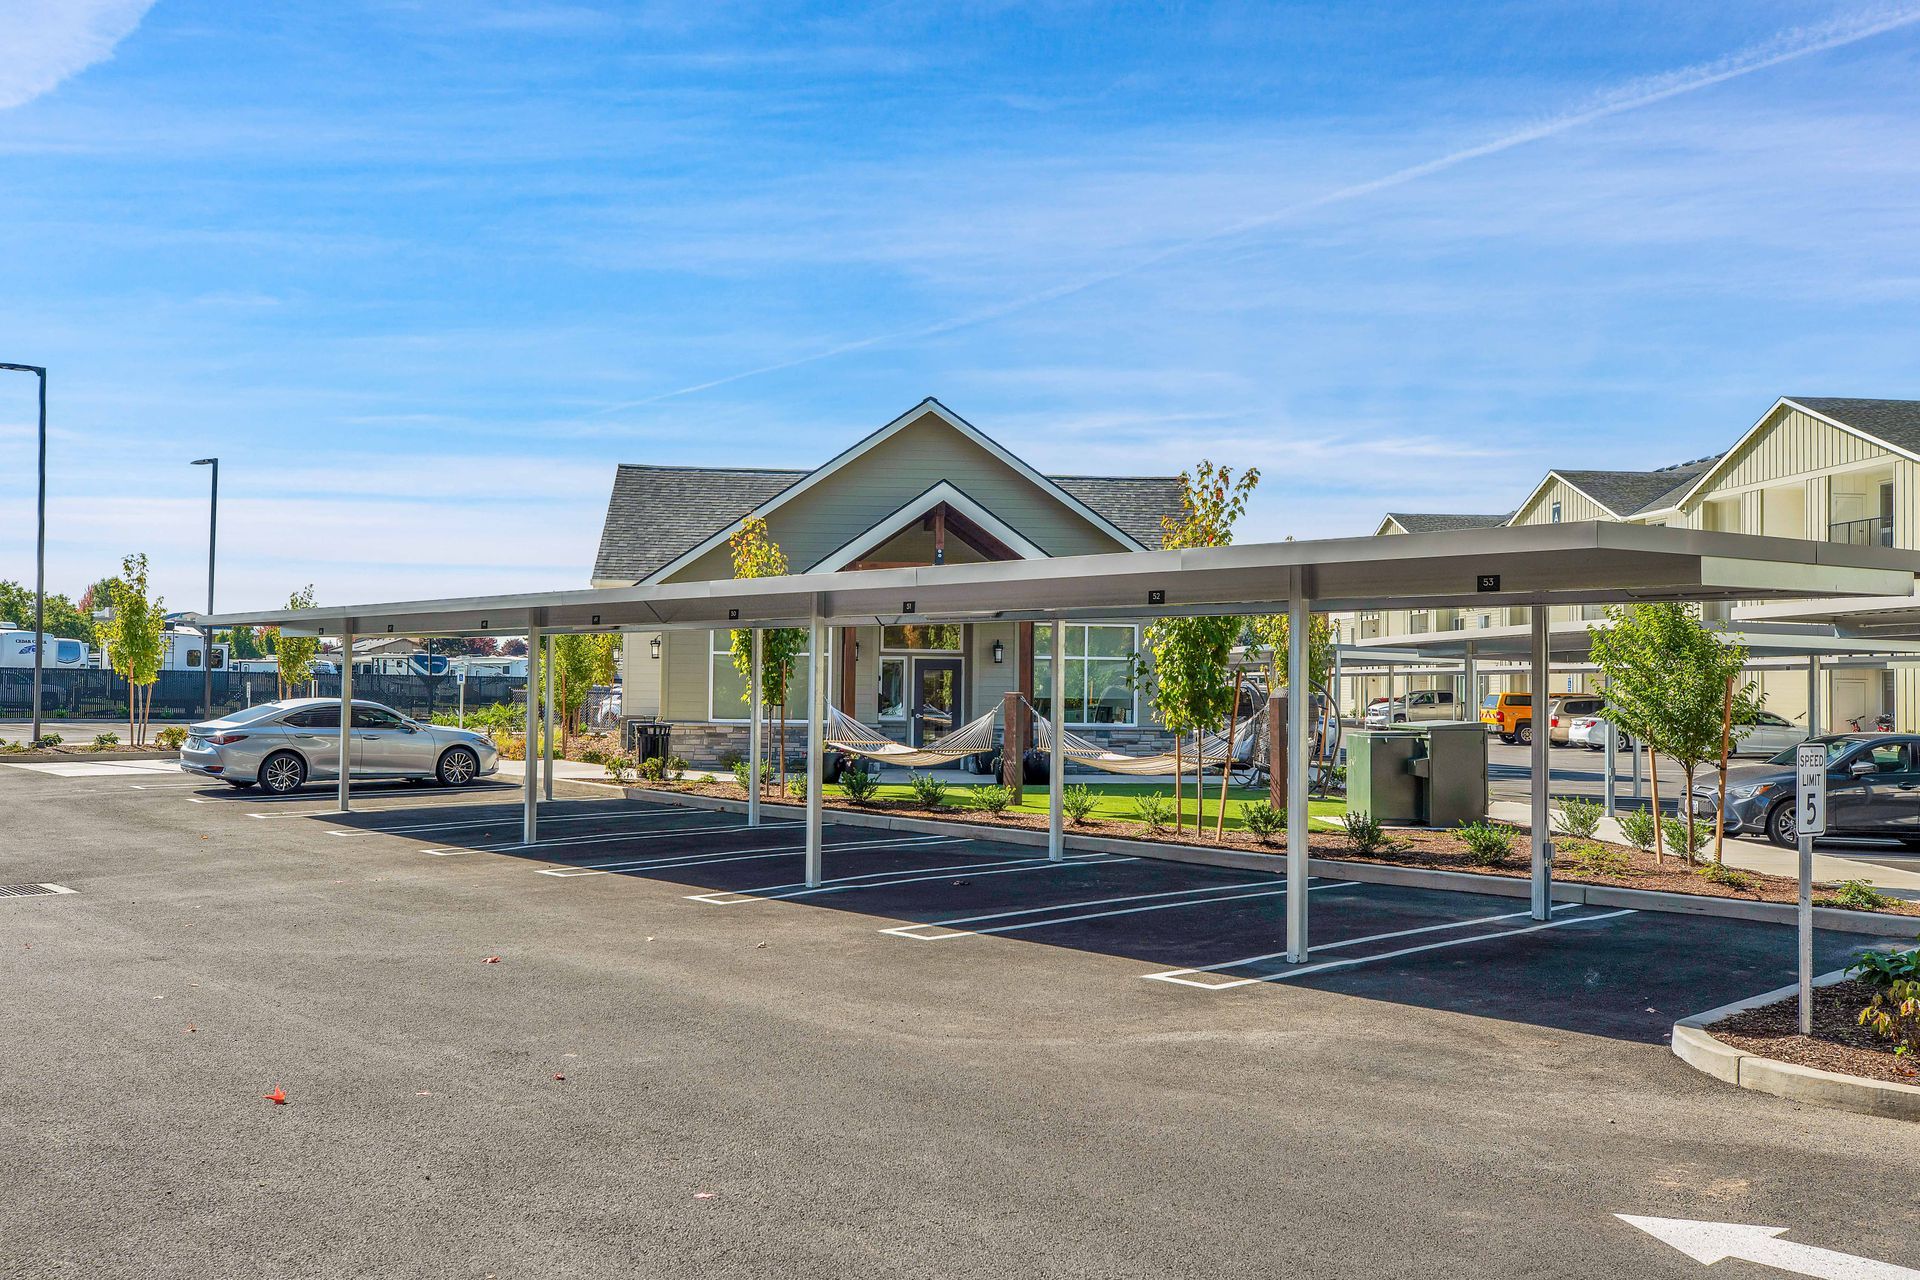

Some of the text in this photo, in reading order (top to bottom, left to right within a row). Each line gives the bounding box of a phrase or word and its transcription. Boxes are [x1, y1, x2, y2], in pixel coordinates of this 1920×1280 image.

[1482, 577, 1494, 586] 53
[1152, 592, 1161, 600] 52
[1800, 755, 1824, 767] SPEED
[1802, 774, 1821, 787] LIMIT
[1806, 793, 1817, 825] 5
